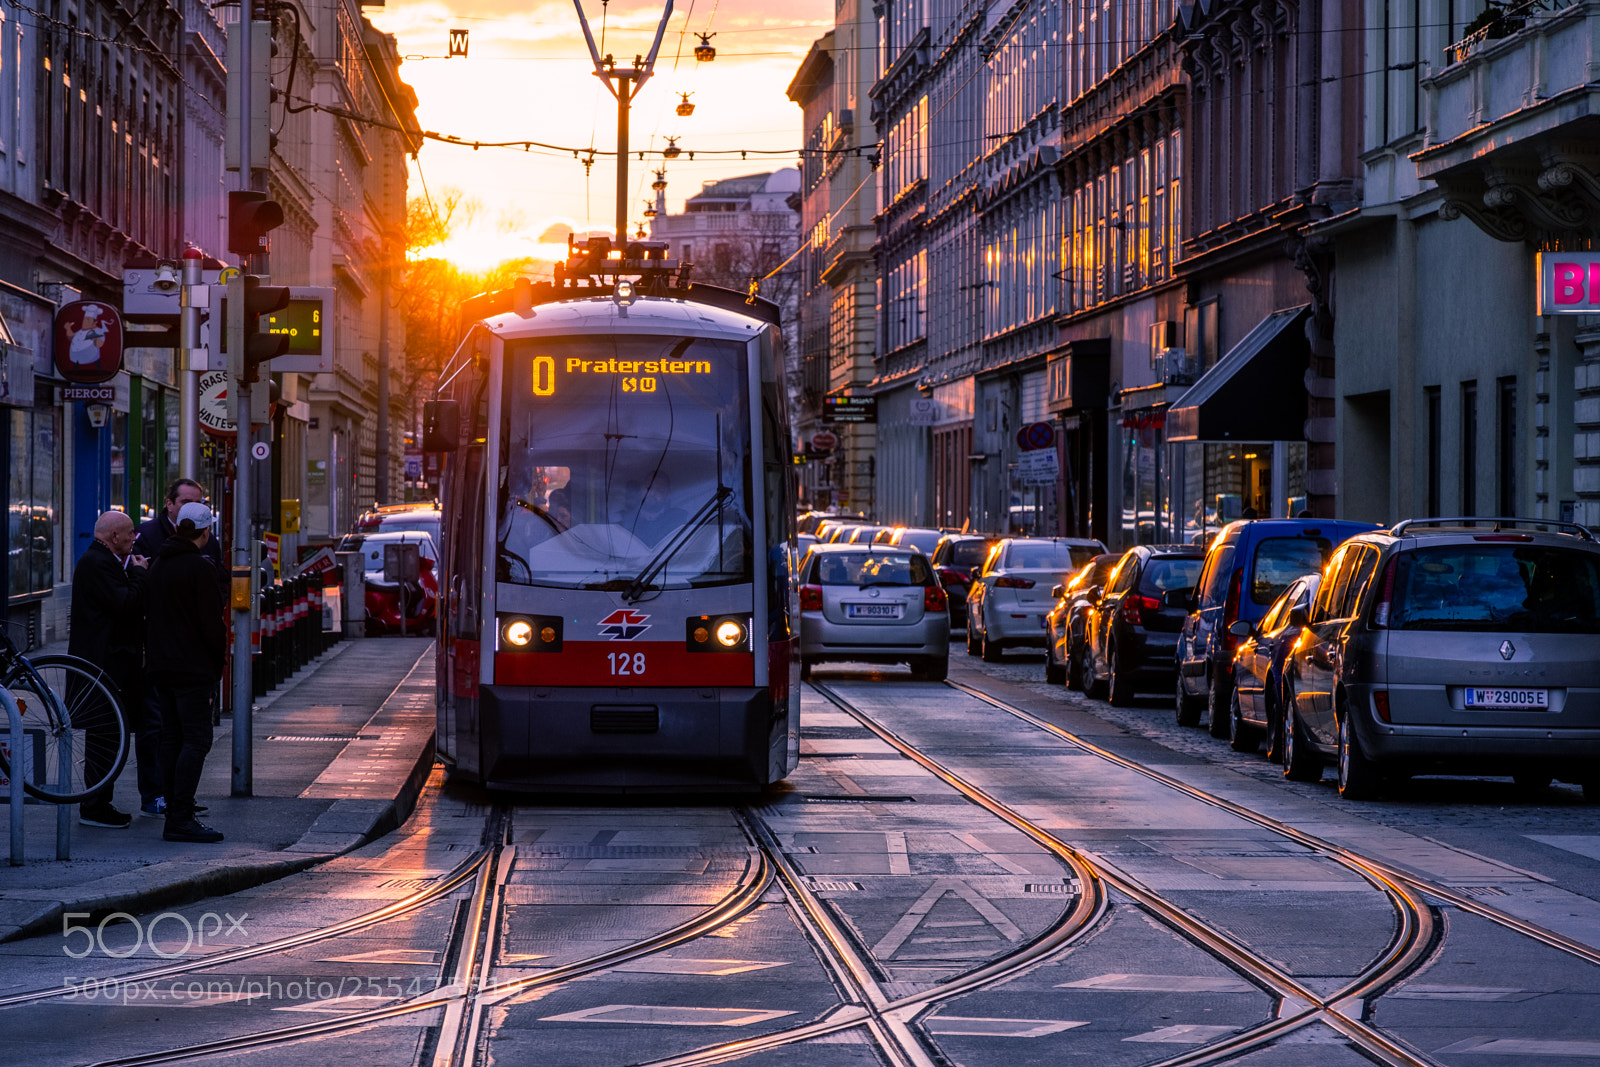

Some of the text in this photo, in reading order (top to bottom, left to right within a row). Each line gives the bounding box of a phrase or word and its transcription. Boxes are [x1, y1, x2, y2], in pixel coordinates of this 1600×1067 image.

[313, 310, 320, 323] 6
[566, 357, 711, 373] Praterstern
[64, 388, 112, 399] PIEROGI
[203, 447, 212, 458] N
[607, 652, 646, 676] 128
[1476, 690, 1544, 704] W 29005 E
